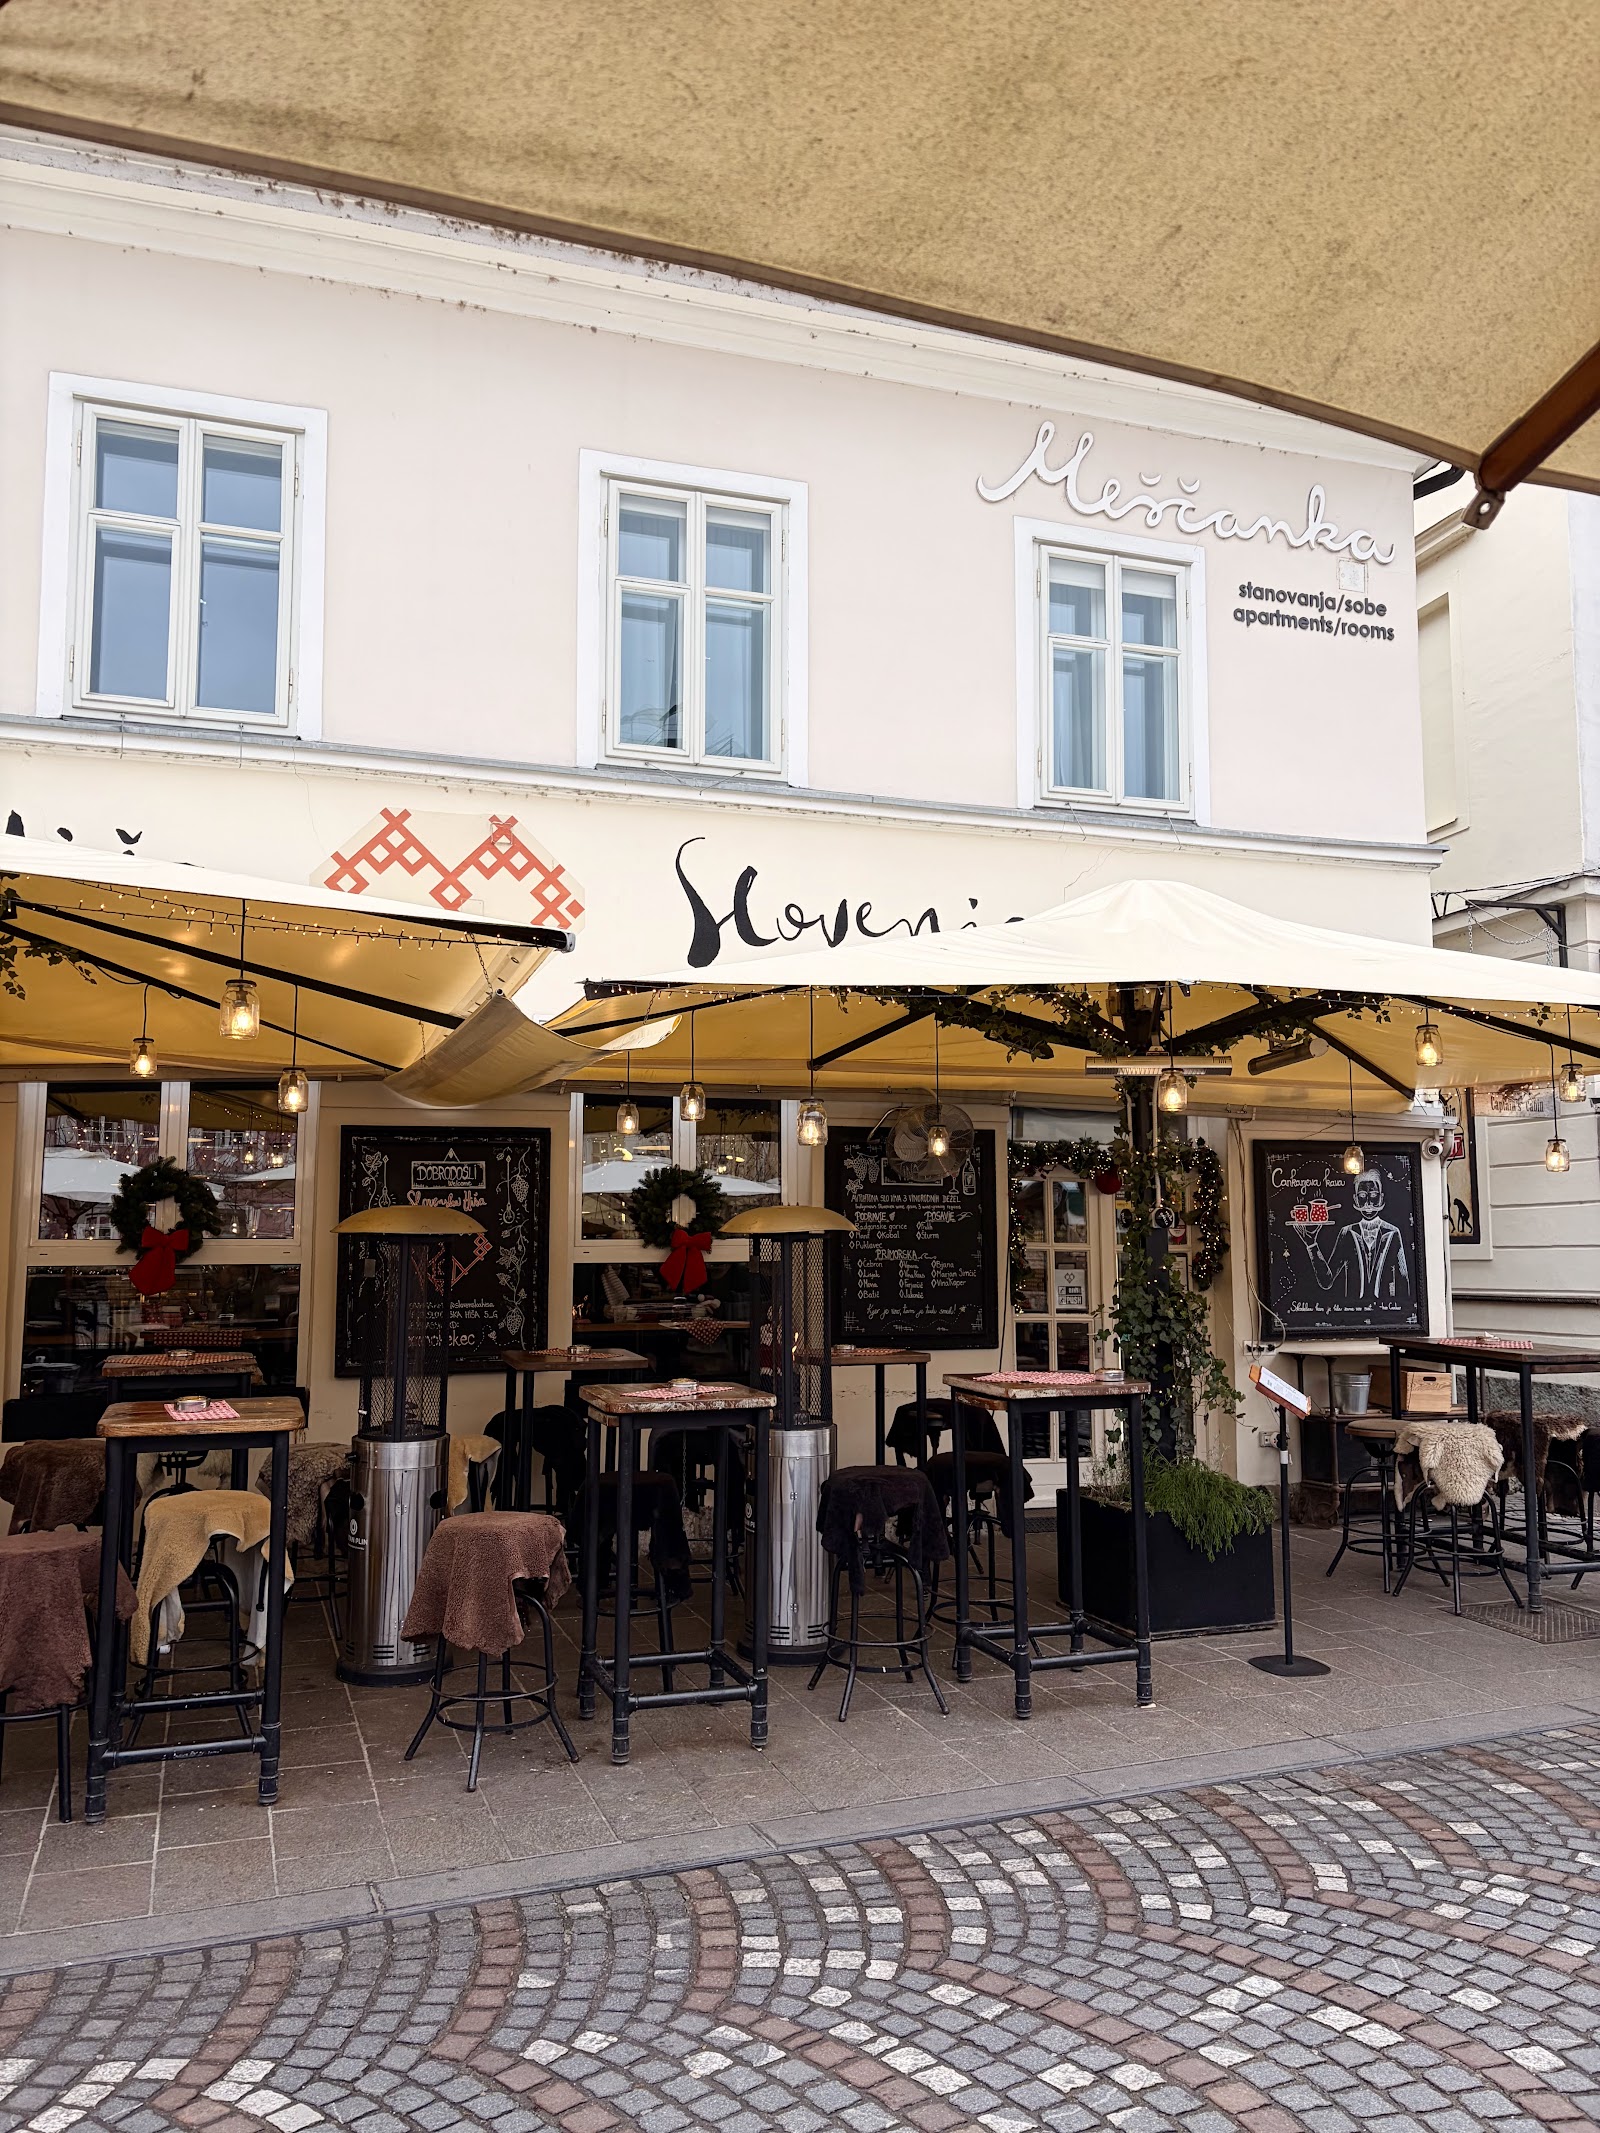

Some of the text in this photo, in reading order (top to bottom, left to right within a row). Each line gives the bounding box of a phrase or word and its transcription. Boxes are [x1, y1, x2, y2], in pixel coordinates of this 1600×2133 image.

[976, 421, 1396, 565] Meščanka
[1238, 581, 1388, 617] stanovanja/sobe
[1233, 607, 1395, 641] apartments/rooms
[675, 836, 1025, 968] Sloveni
[1525, 1099, 1544, 1112] Cabin
[903, 1194, 907, 1203] 3
